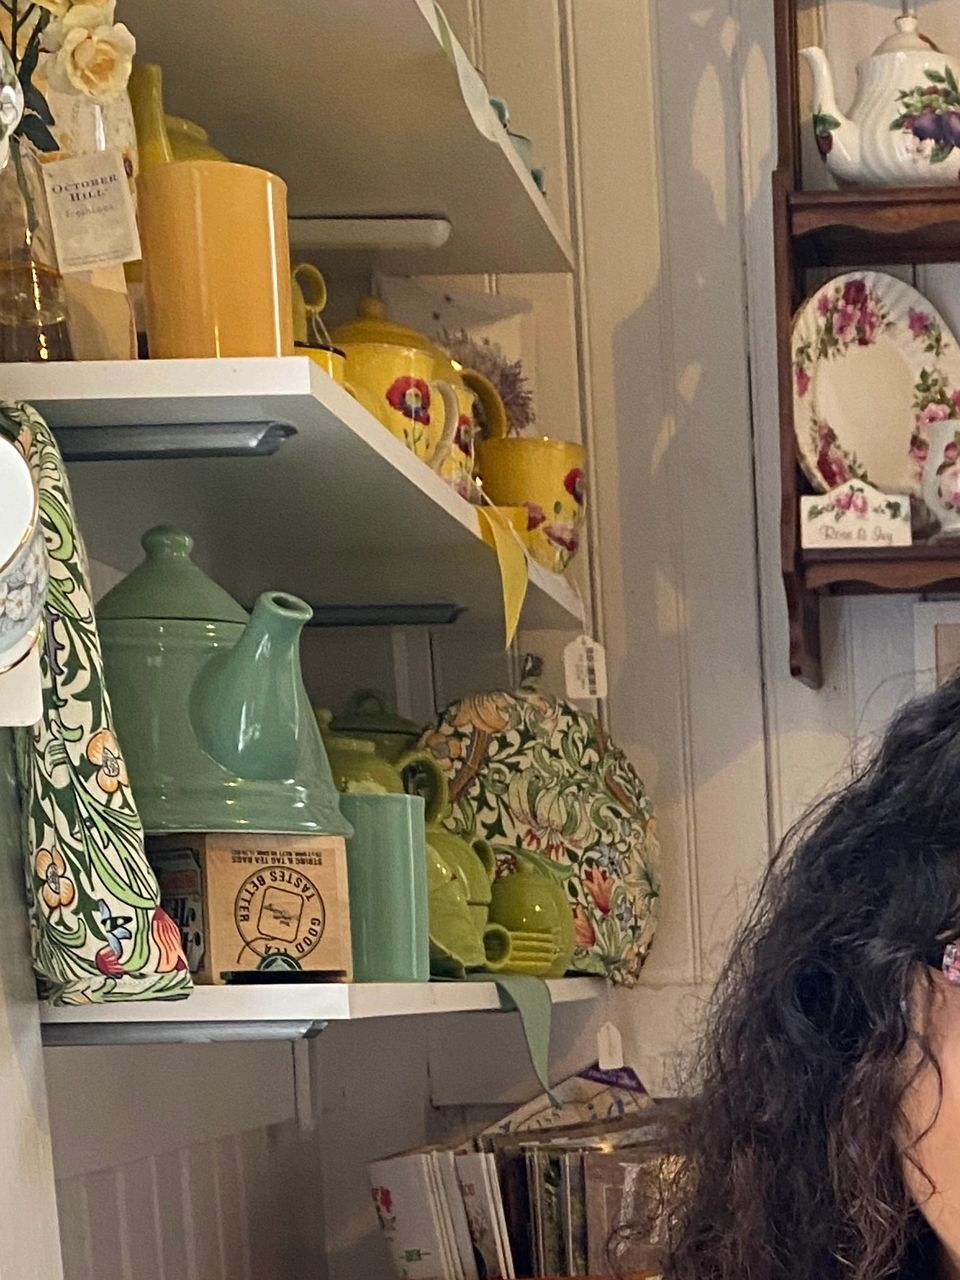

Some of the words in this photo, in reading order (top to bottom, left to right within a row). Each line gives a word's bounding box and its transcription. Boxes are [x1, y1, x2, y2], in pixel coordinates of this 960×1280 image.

[239, 874, 266, 923] BETTER
[269, 870, 316, 902] TASTES
[295, 917, 321, 954] GOOD
